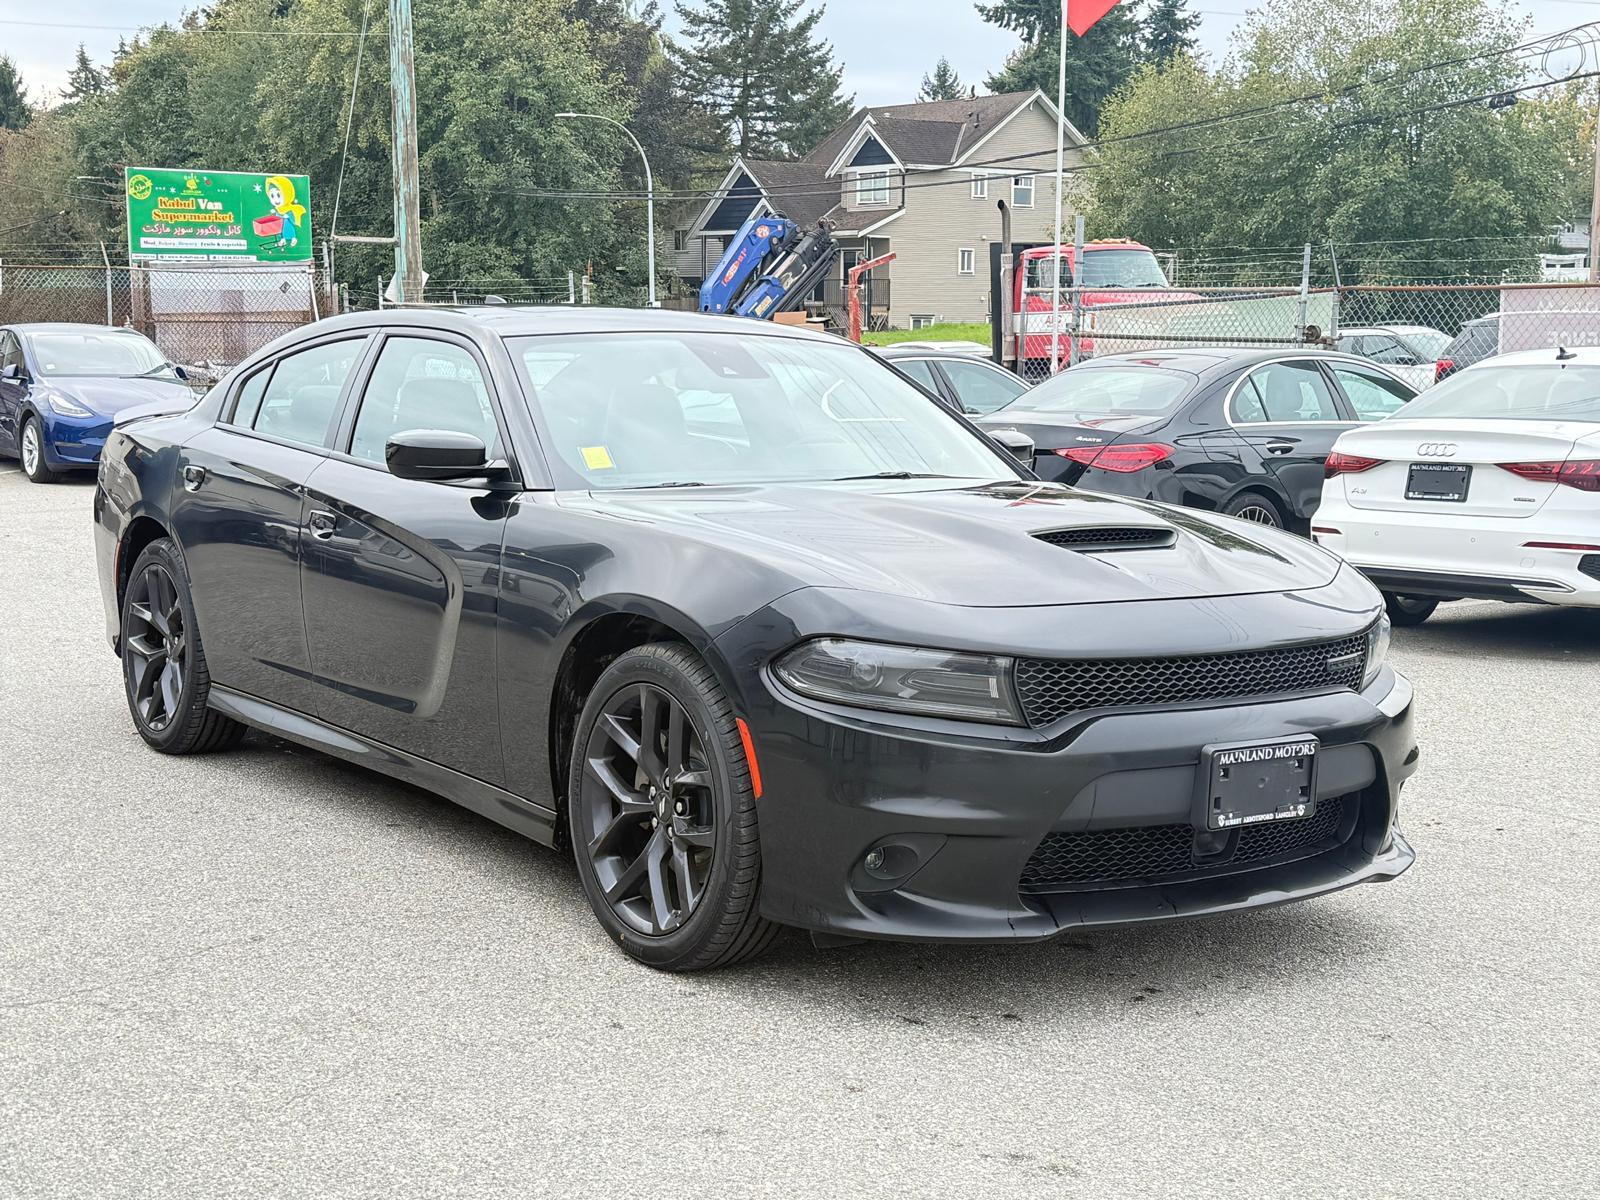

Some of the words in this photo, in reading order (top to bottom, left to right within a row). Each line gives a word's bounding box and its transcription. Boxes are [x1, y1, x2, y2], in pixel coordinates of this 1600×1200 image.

[158, 197, 196, 209] Kabul
[198, 199, 222, 210] Van
[153, 211, 233, 223] Supermarket
